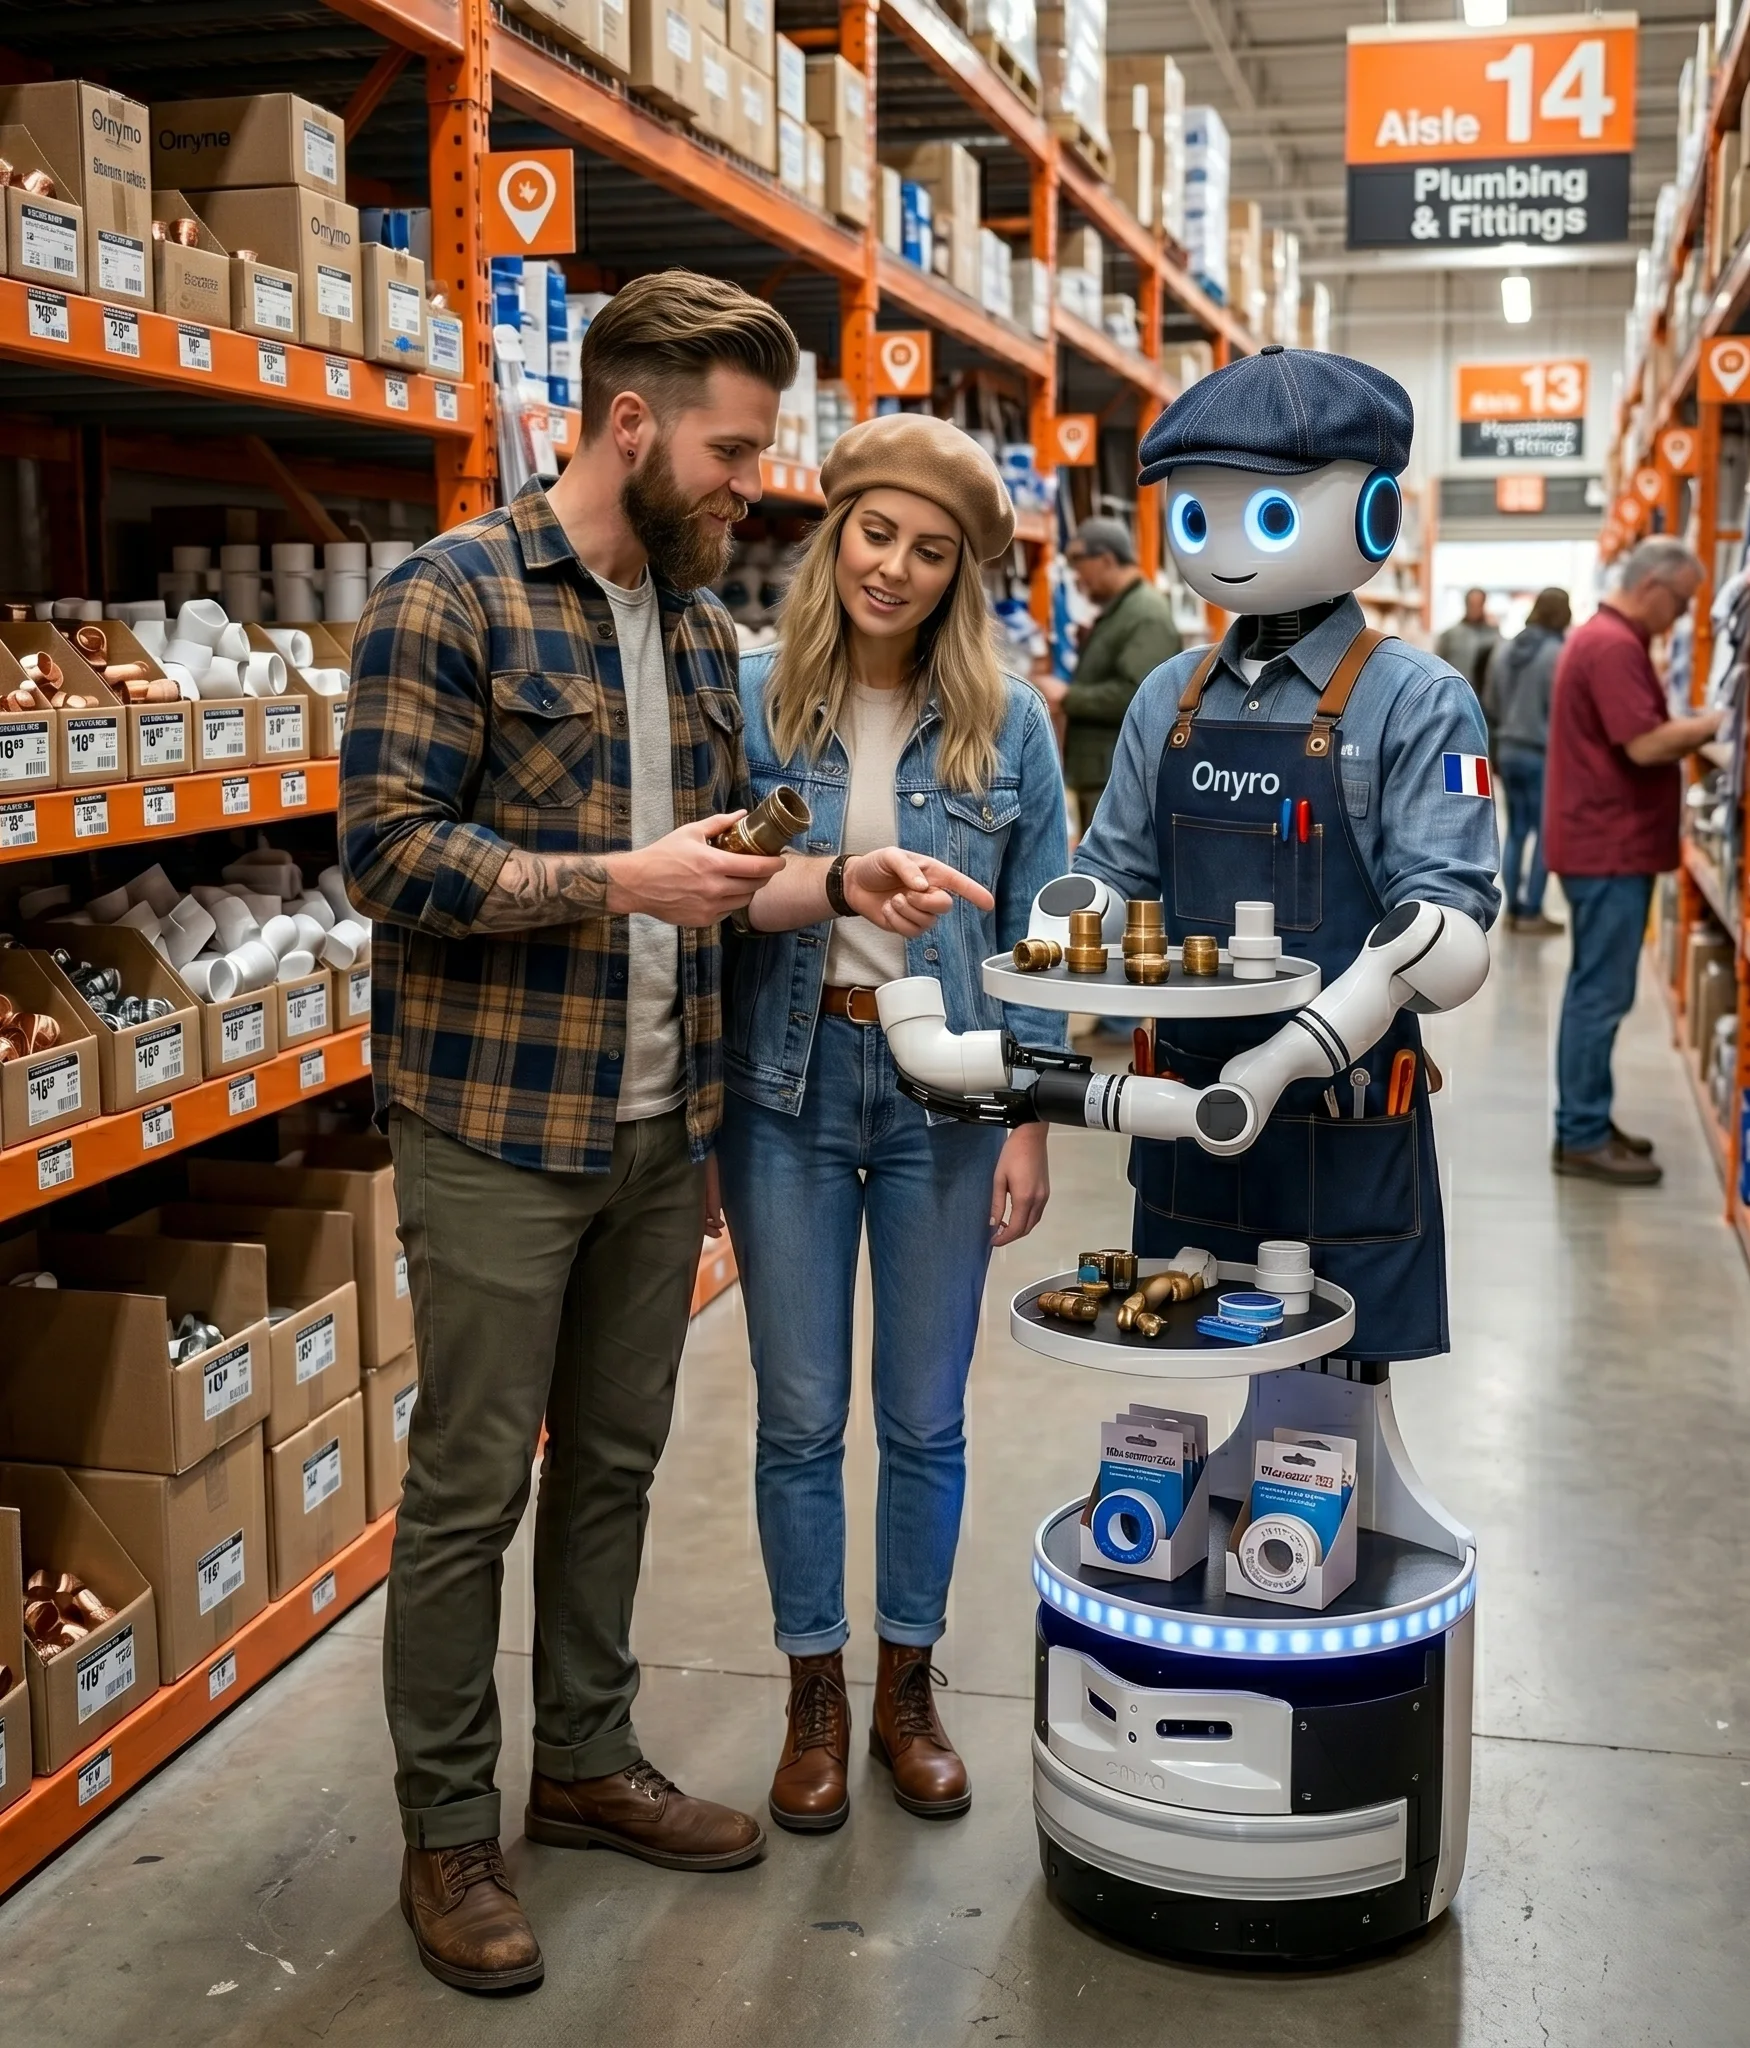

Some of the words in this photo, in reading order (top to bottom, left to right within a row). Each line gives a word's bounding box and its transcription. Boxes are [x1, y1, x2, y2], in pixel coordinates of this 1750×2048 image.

[1375, 107, 1480, 147] Aisle
[1485, 39, 1616, 143] 14
[1414, 164, 1588, 203] Plumbing
[1411, 205, 1441, 239] &
[1448, 203, 1588, 242] Fittings
[1521, 364, 1582, 414] 13
[1192, 760, 1280, 801] Onyro
